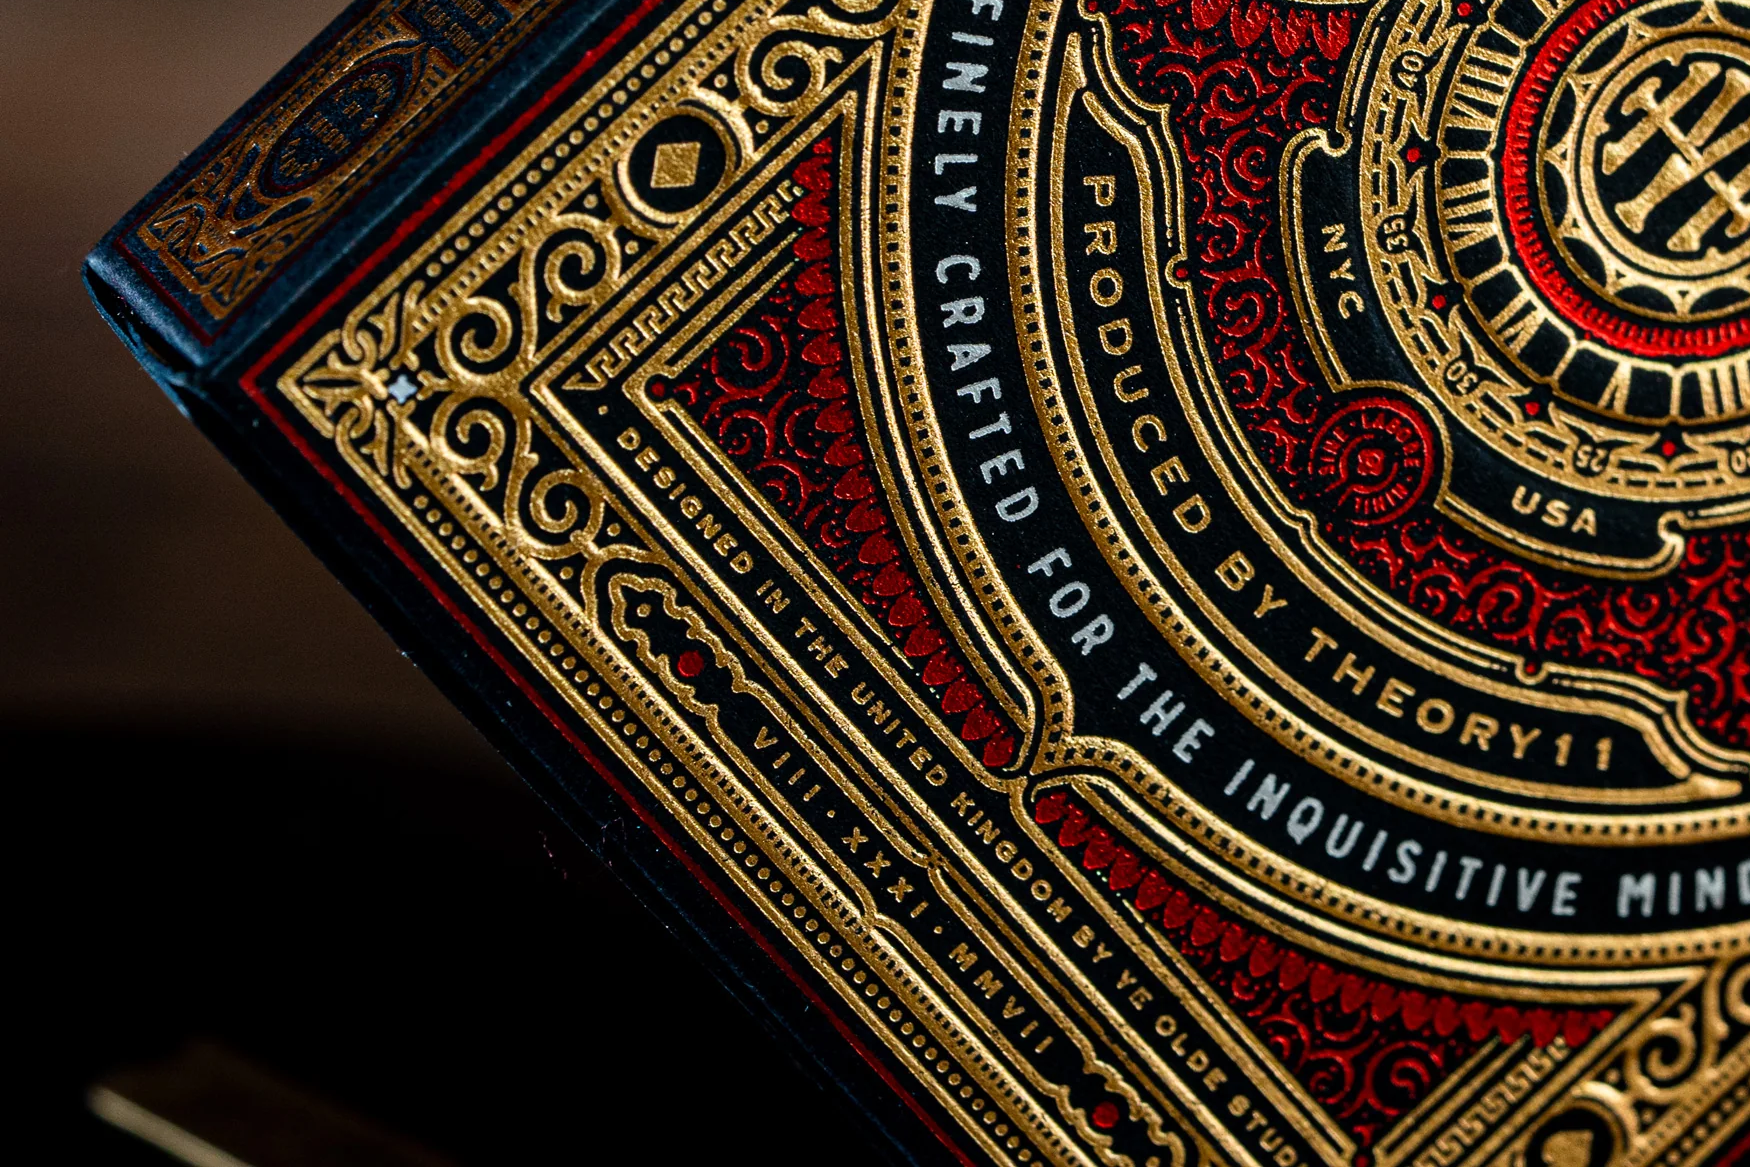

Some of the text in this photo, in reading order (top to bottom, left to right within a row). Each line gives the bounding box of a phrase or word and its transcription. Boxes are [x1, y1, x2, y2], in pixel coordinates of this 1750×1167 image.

[1083, 175, 1611, 770] PRODUCED BY THEORY11
[1322, 223, 1364, 319] NYC
[935, 255, 1039, 522] CRAFTED
[1028, 548, 1114, 655] FOR
[1117, 663, 1214, 763] THE
[1224, 760, 1580, 915] INQUISITIVE
[1512, 486, 1596, 535] USA
[617, 427, 1307, 1167] DESIGNED IN THE UNITED KINGDOM BY YE OLDE STUD
[754, 726, 1052, 1053] VIII XXXI MMVII
